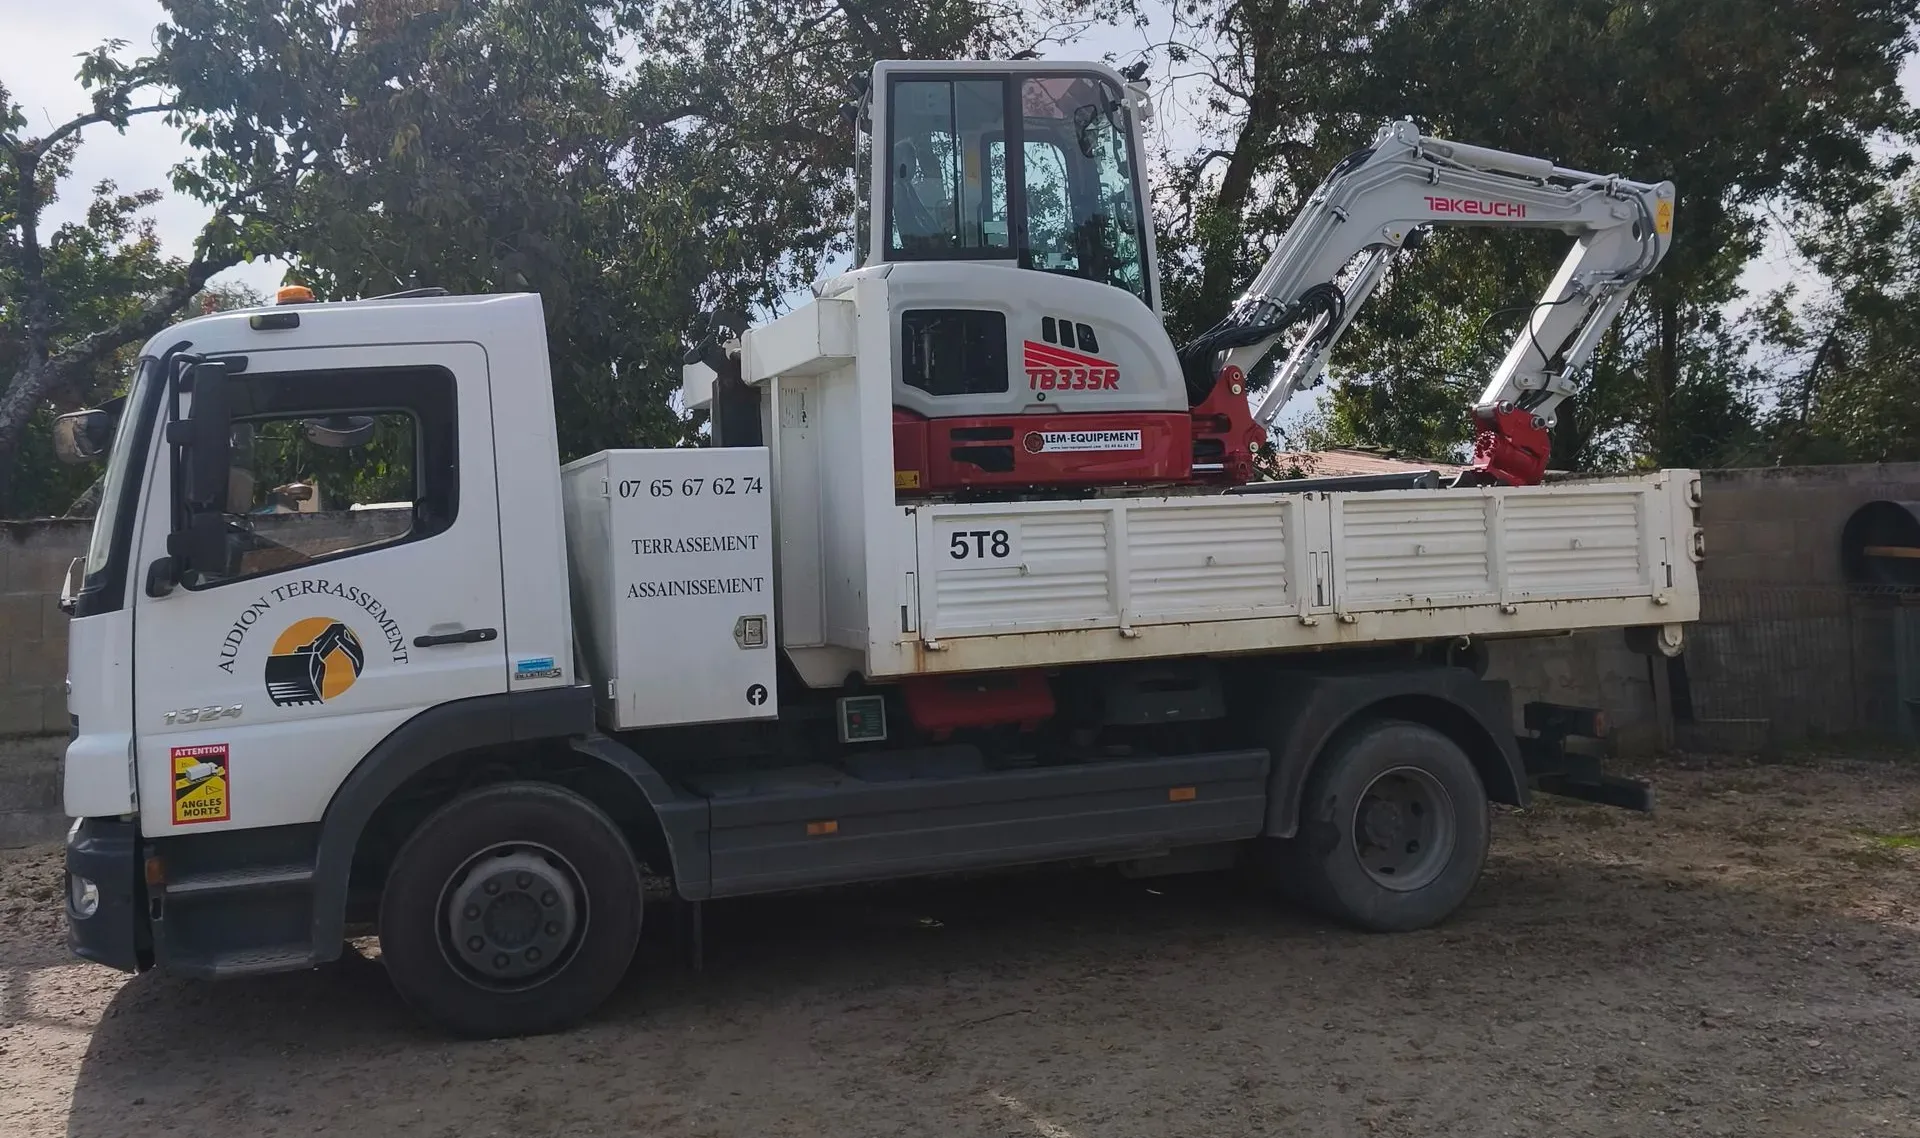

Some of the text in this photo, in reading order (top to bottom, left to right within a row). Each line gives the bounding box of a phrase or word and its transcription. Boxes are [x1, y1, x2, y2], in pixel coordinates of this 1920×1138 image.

[1025, 368, 1121, 390] TB335R
[1045, 432, 1139, 444] LEM-EQUIPEMENT
[619, 477, 763, 498] 07 65 67 62 74
[631, 535, 759, 555] TERRASSEMENT
[950, 529, 1010, 560] 5T8
[627, 577, 764, 599] ASSAINISSEMENT
[218, 579, 409, 675] AUDION TERRASSEMENT
[163, 703, 243, 726] 1324
[175, 745, 226, 757] ATTENTION
[181, 798, 222, 809] ANGLES
[183, 807, 221, 817] MORTS
